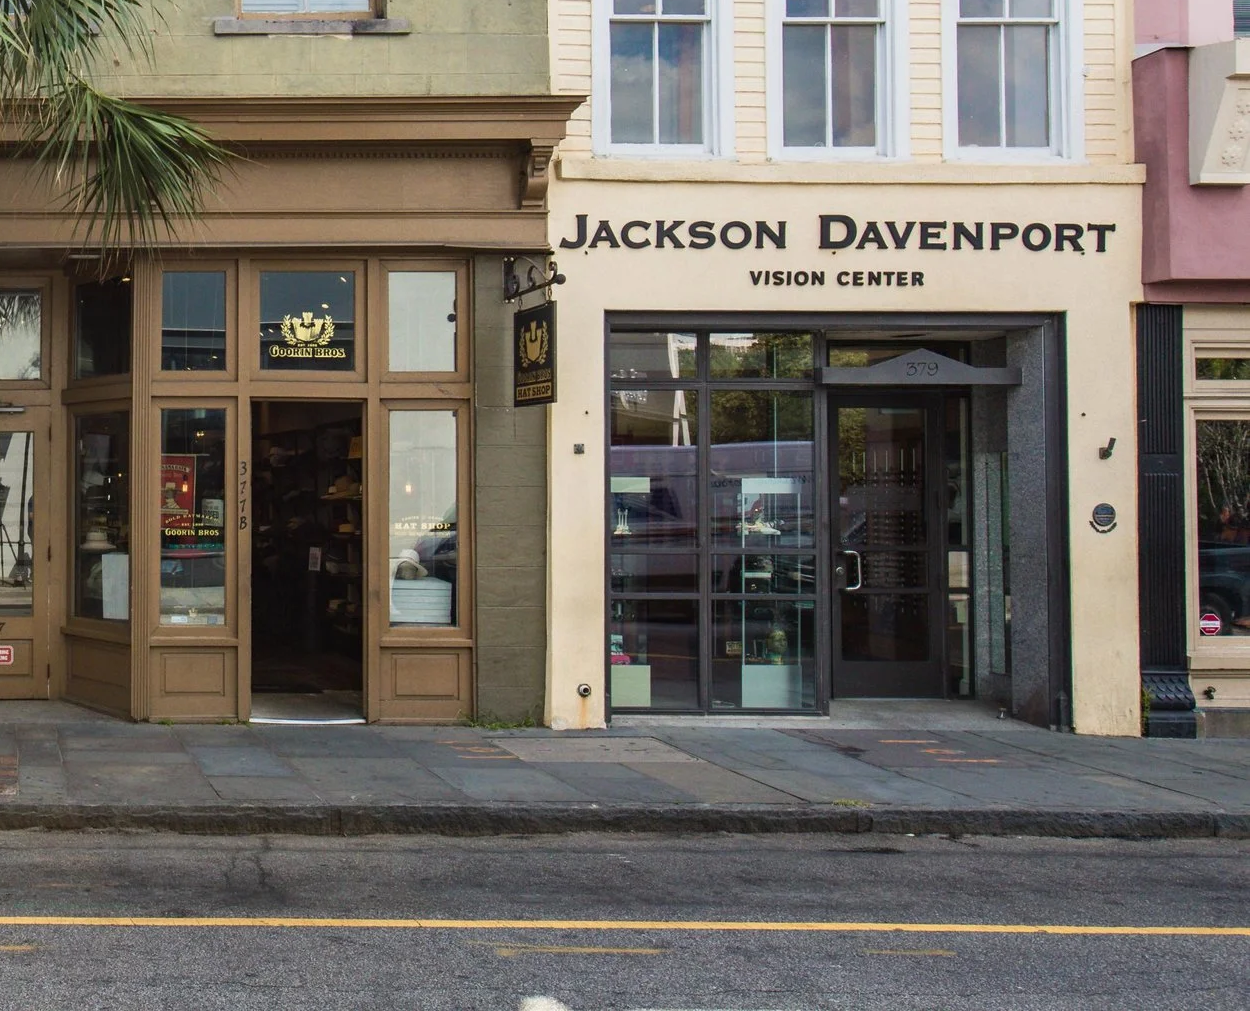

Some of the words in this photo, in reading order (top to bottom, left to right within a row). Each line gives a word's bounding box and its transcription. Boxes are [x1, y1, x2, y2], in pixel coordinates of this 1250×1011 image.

[559, 214, 786, 250] JACKSON
[818, 214, 1117, 252] DAVENPORT
[749, 271, 825, 286] VISION
[836, 271, 925, 287] CENTER
[269, 345, 312, 357] GOORIN
[906, 362, 939, 376] 379
[517, 387, 531, 398] HAT
[532, 384, 551, 396] SHOP
[165, 528, 195, 536] GOORIN
